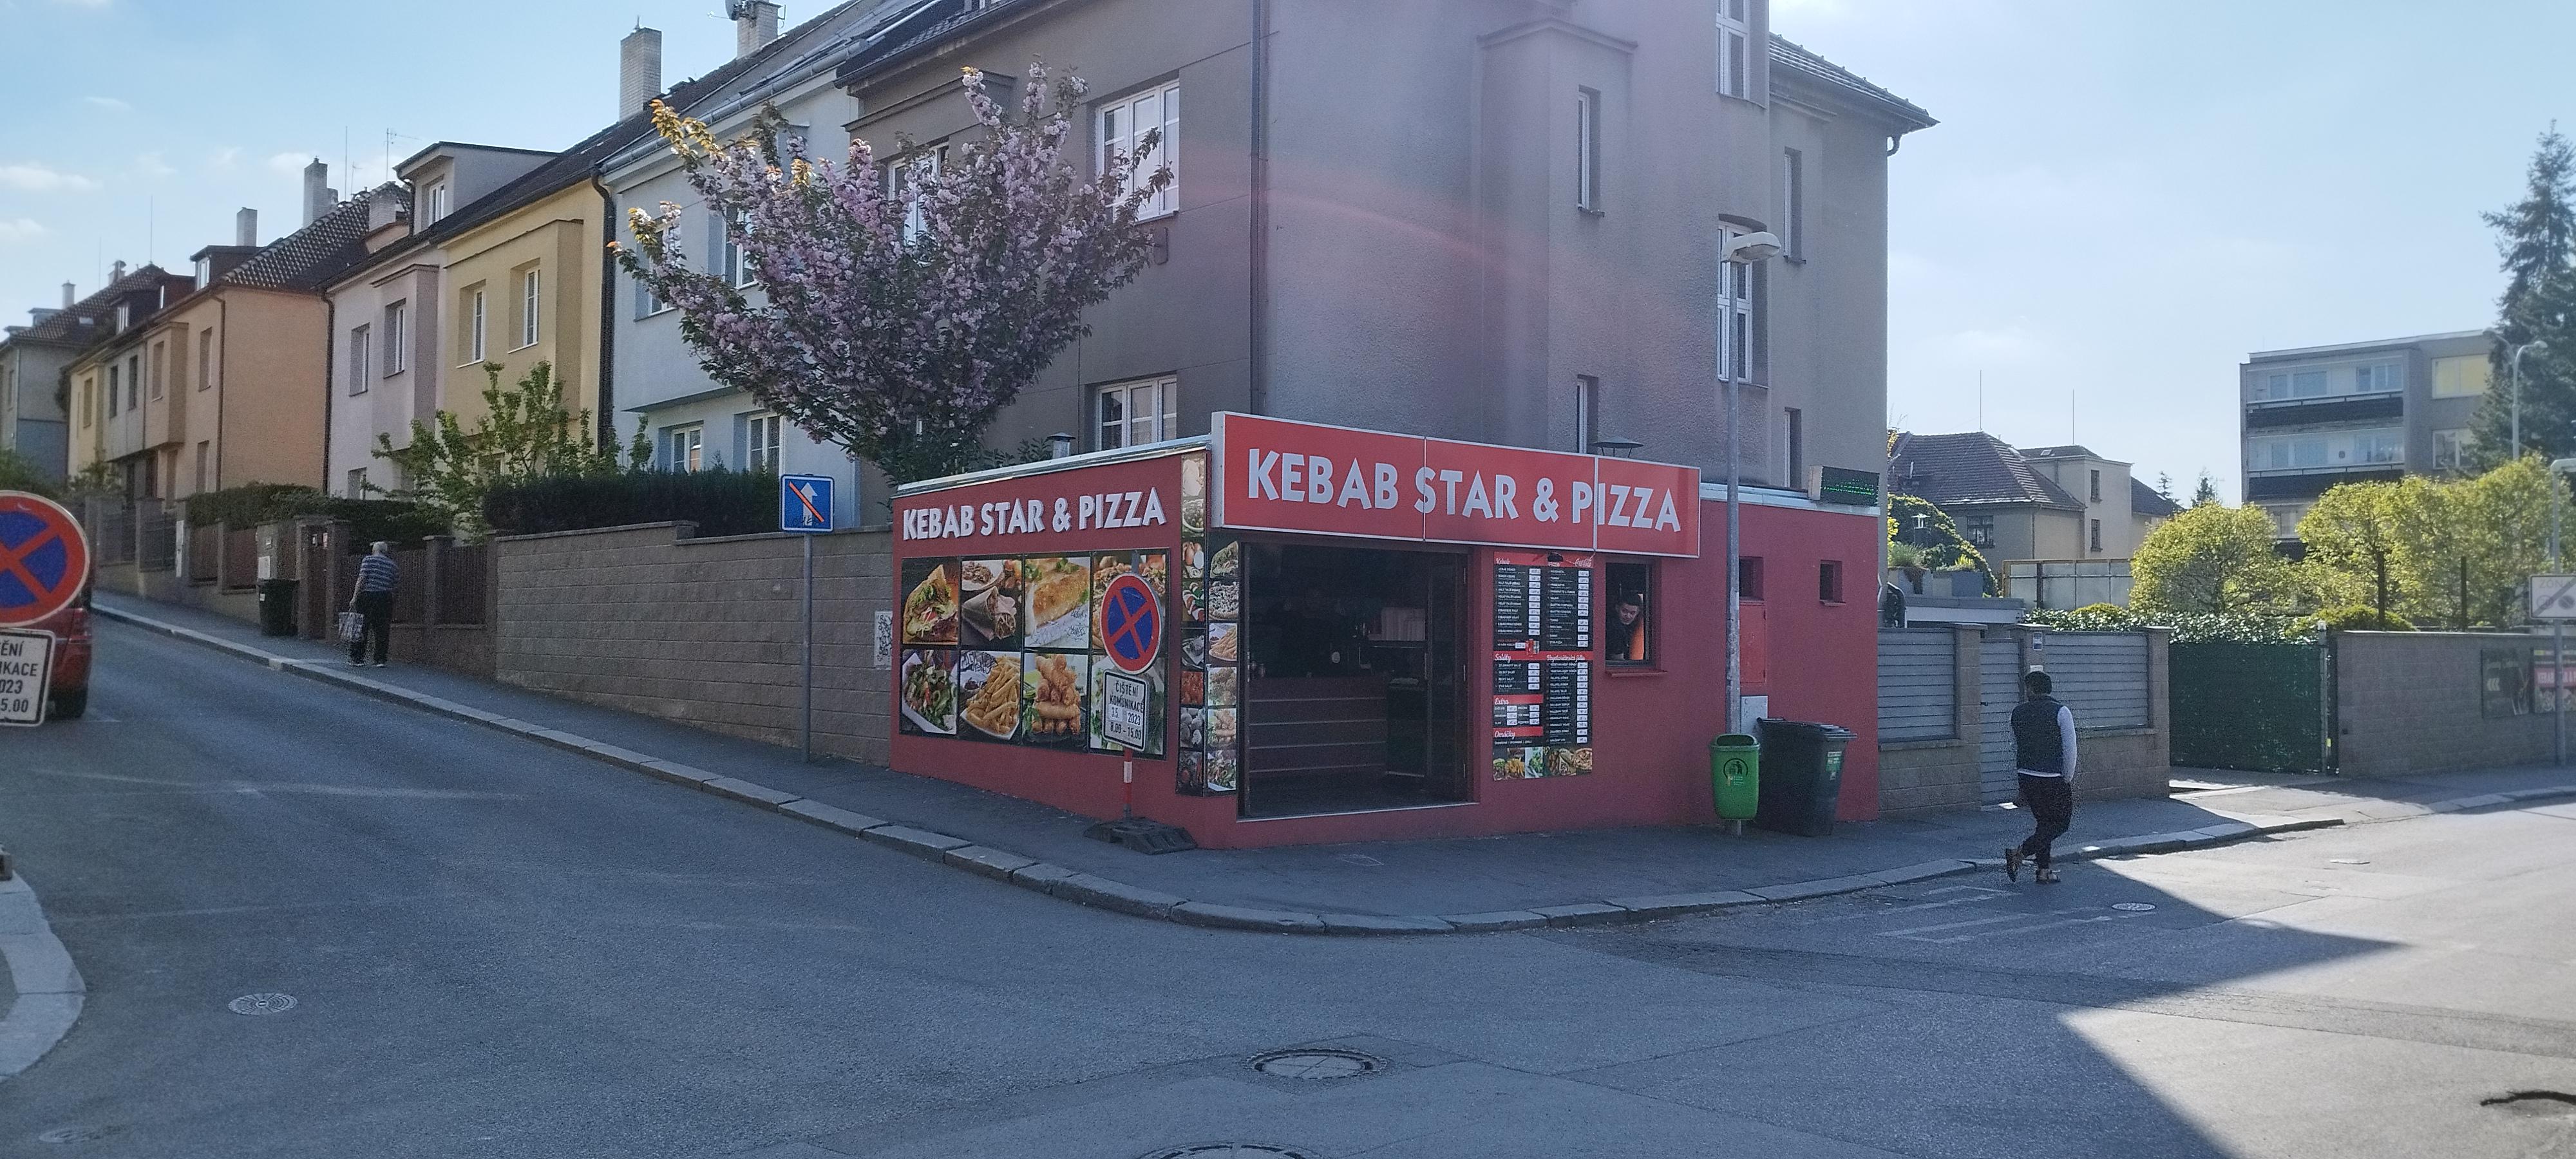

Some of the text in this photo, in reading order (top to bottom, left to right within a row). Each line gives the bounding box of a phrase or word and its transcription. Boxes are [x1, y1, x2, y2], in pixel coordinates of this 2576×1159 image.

[1248, 448, 1681, 532] KEBAB STAR & PIZZA
[903, 486, 1167, 541] KEBAB STAR & PIZZA
[1115, 681, 1139, 697] ČIŠTĚNÍ
[1109, 695, 1144, 713] KOMUNIKACE
[1128, 712, 1141, 725] 2023
[1110, 722, 1122, 733] 8.00
[1128, 726, 1142, 740] 15.00
